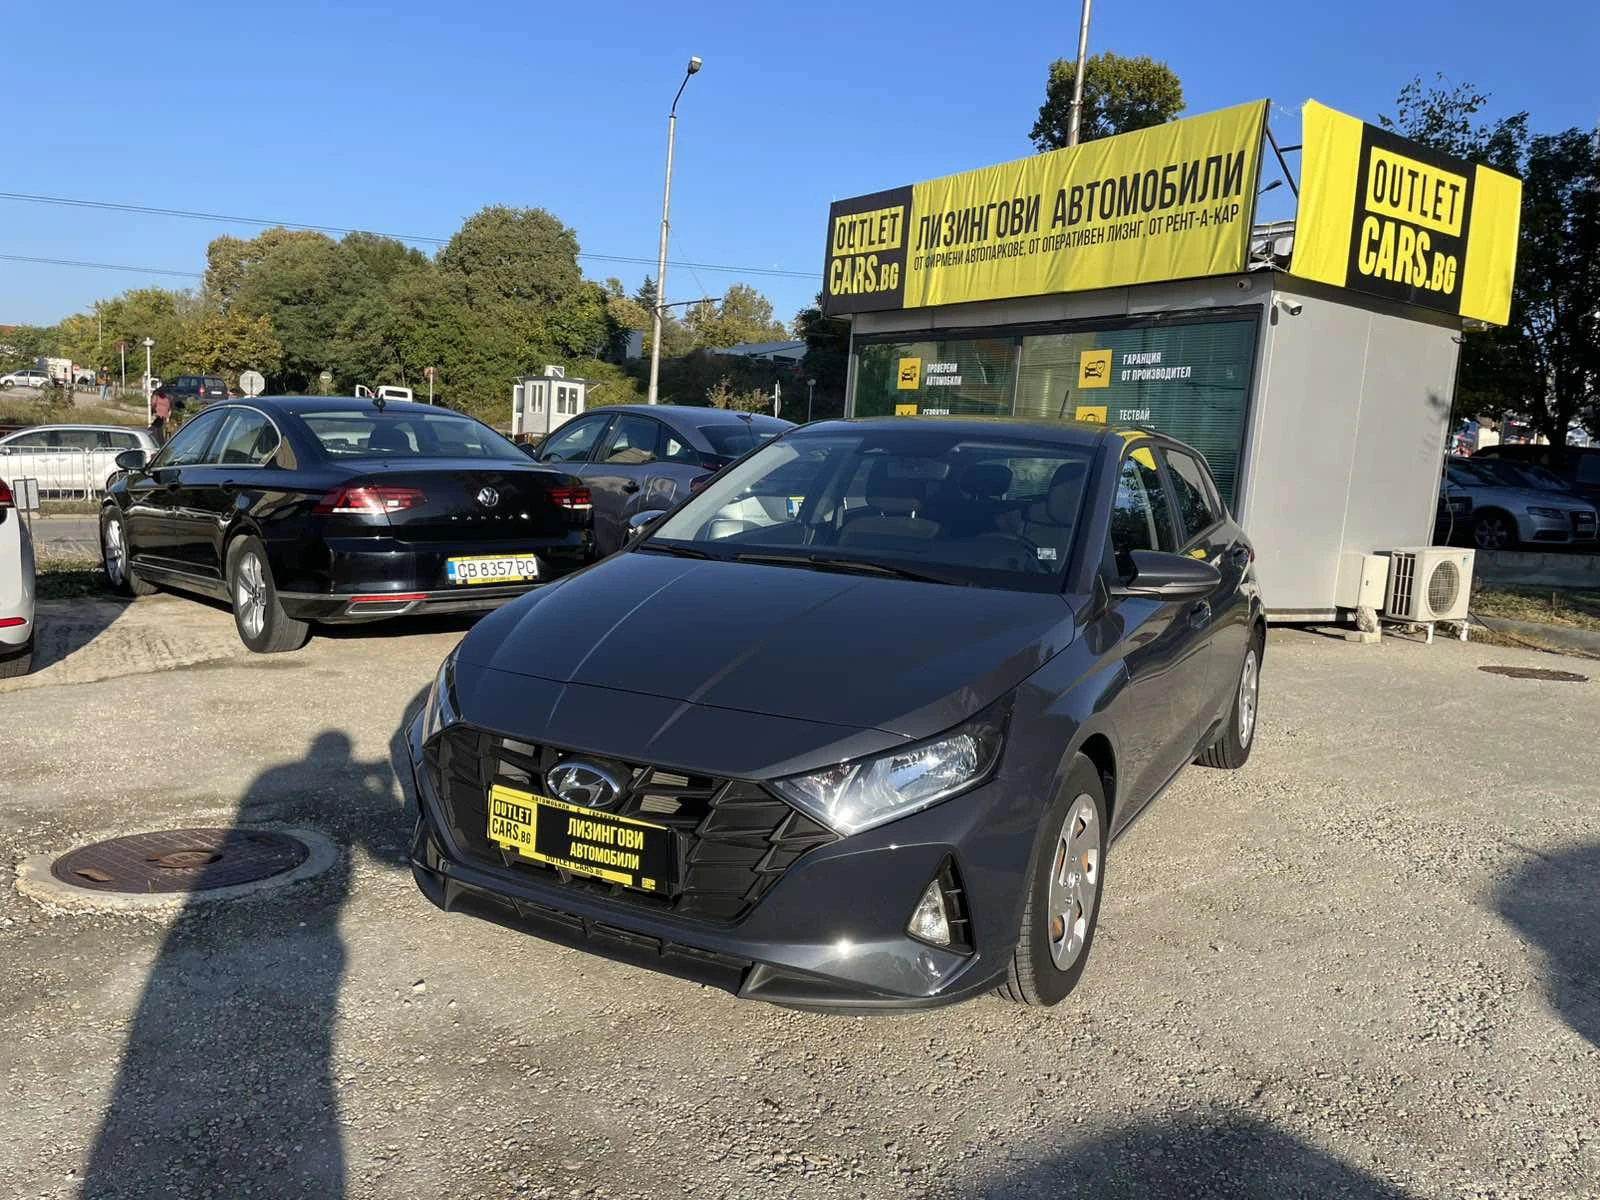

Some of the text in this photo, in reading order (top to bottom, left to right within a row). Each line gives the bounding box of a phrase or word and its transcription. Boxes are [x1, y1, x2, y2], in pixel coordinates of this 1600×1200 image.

[916, 150, 1245, 251] ЛИЗИНГОВИ АВТОМОБИЛИ
[1373, 159, 1460, 225] OUTLET
[837, 213, 900, 250] OUTLET
[914, 256, 923, 271] ОТ
[924, 252, 963, 269] ФИРМЕНИ
[965, 240, 1026, 264] АВТОПАРКОВЕ,
[1028, 238, 1041, 254] ОТ
[1042, 226, 1104, 252] ОПЕРАТИВЕН
[1149, 216, 1164, 236] ОТ
[1165, 203, 1239, 232] РЕНТ-А-КАР
[1358, 216, 1457, 295] CARS.BG
[829, 254, 899, 296] CARS.BG
[1121, 366, 1191, 381] ОТ ПРОИЗВОДИТЕЛ
[1122, 352, 1162, 365] ГАРАНЦИЯ
[1119, 408, 1151, 420] ТЕСТВАЙ
[480, 561, 514, 577] 8357
[494, 801, 531, 824] OUTLET
[492, 818, 531, 844] CARS.BG
[567, 817, 644, 850] ЛИЗИНГОВИ
[569, 842, 640, 870] АВТОМОБИЛИ
